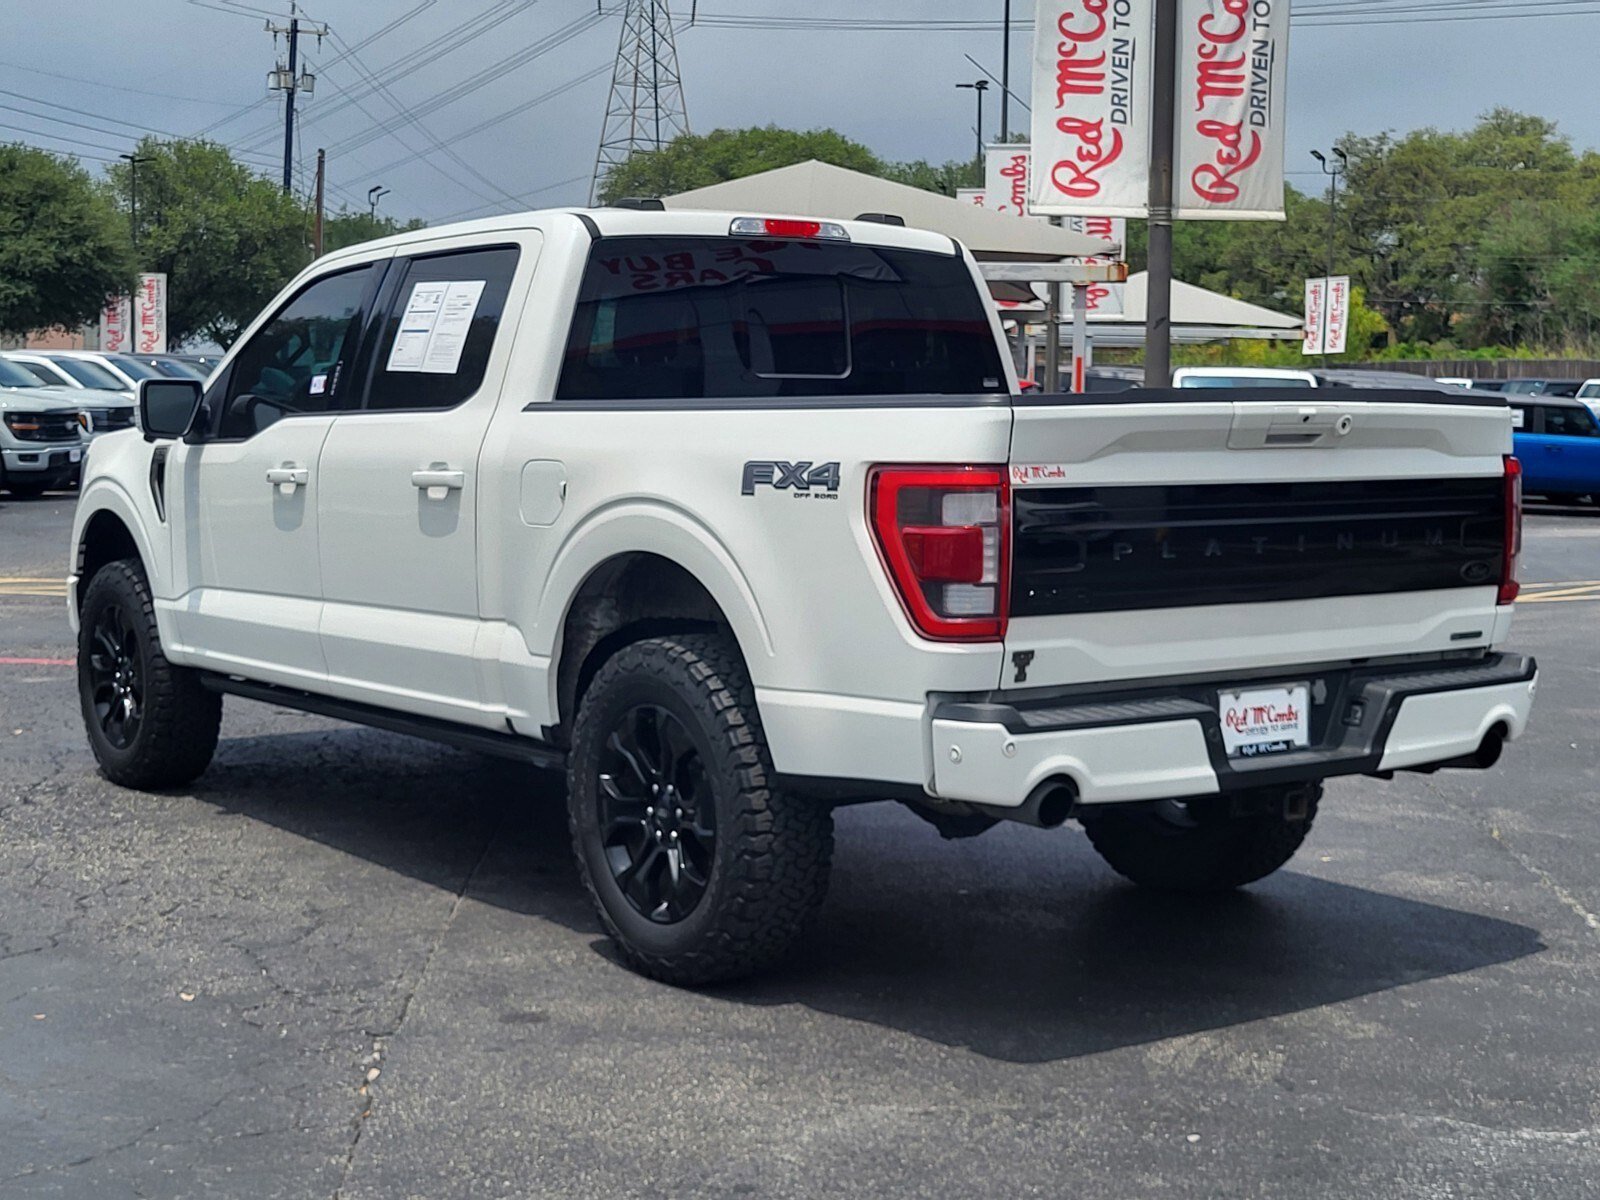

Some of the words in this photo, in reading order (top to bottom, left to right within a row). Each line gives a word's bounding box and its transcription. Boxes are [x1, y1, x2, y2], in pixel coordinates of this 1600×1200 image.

[1112, 0, 1131, 30] TO
[1253, 0, 1271, 32] TO
[1110, 37, 1130, 125] DRIVEN
[1250, 39, 1269, 127] DRIVEN
[1051, 117, 1123, 198] Red
[1191, 119, 1261, 203] Red
[141, 329, 159, 352] Red
[741, 461, 840, 496] FX4
[1012, 465, 1028, 484] Red
[1112, 528, 1444, 561] PLATINUM
[1226, 707, 1247, 733] Red
